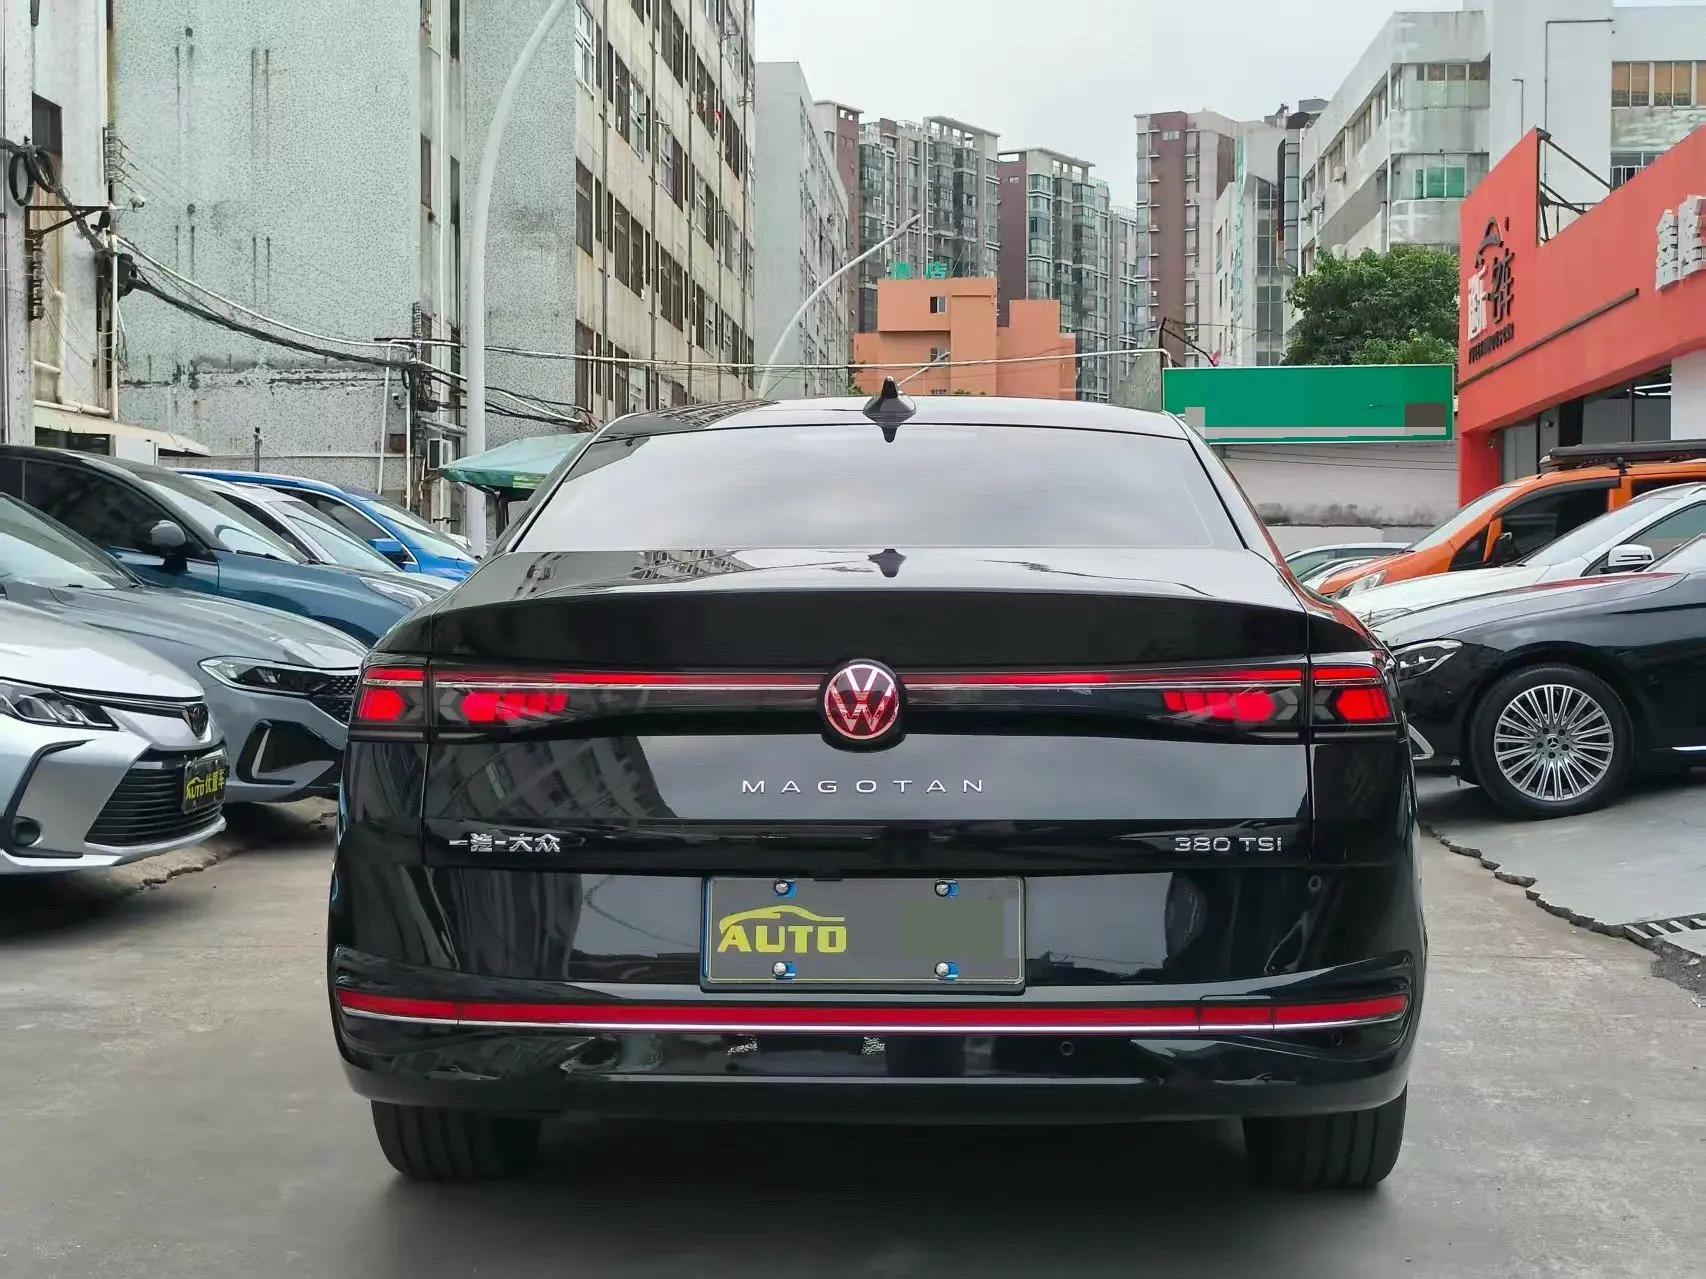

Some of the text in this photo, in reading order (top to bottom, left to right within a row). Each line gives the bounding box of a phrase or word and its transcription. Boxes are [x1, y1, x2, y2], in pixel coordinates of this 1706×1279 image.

[741, 779, 983, 794] MAGOTAN
[1174, 836, 1282, 852] 380 TSI
[716, 925, 847, 954] AUTO
